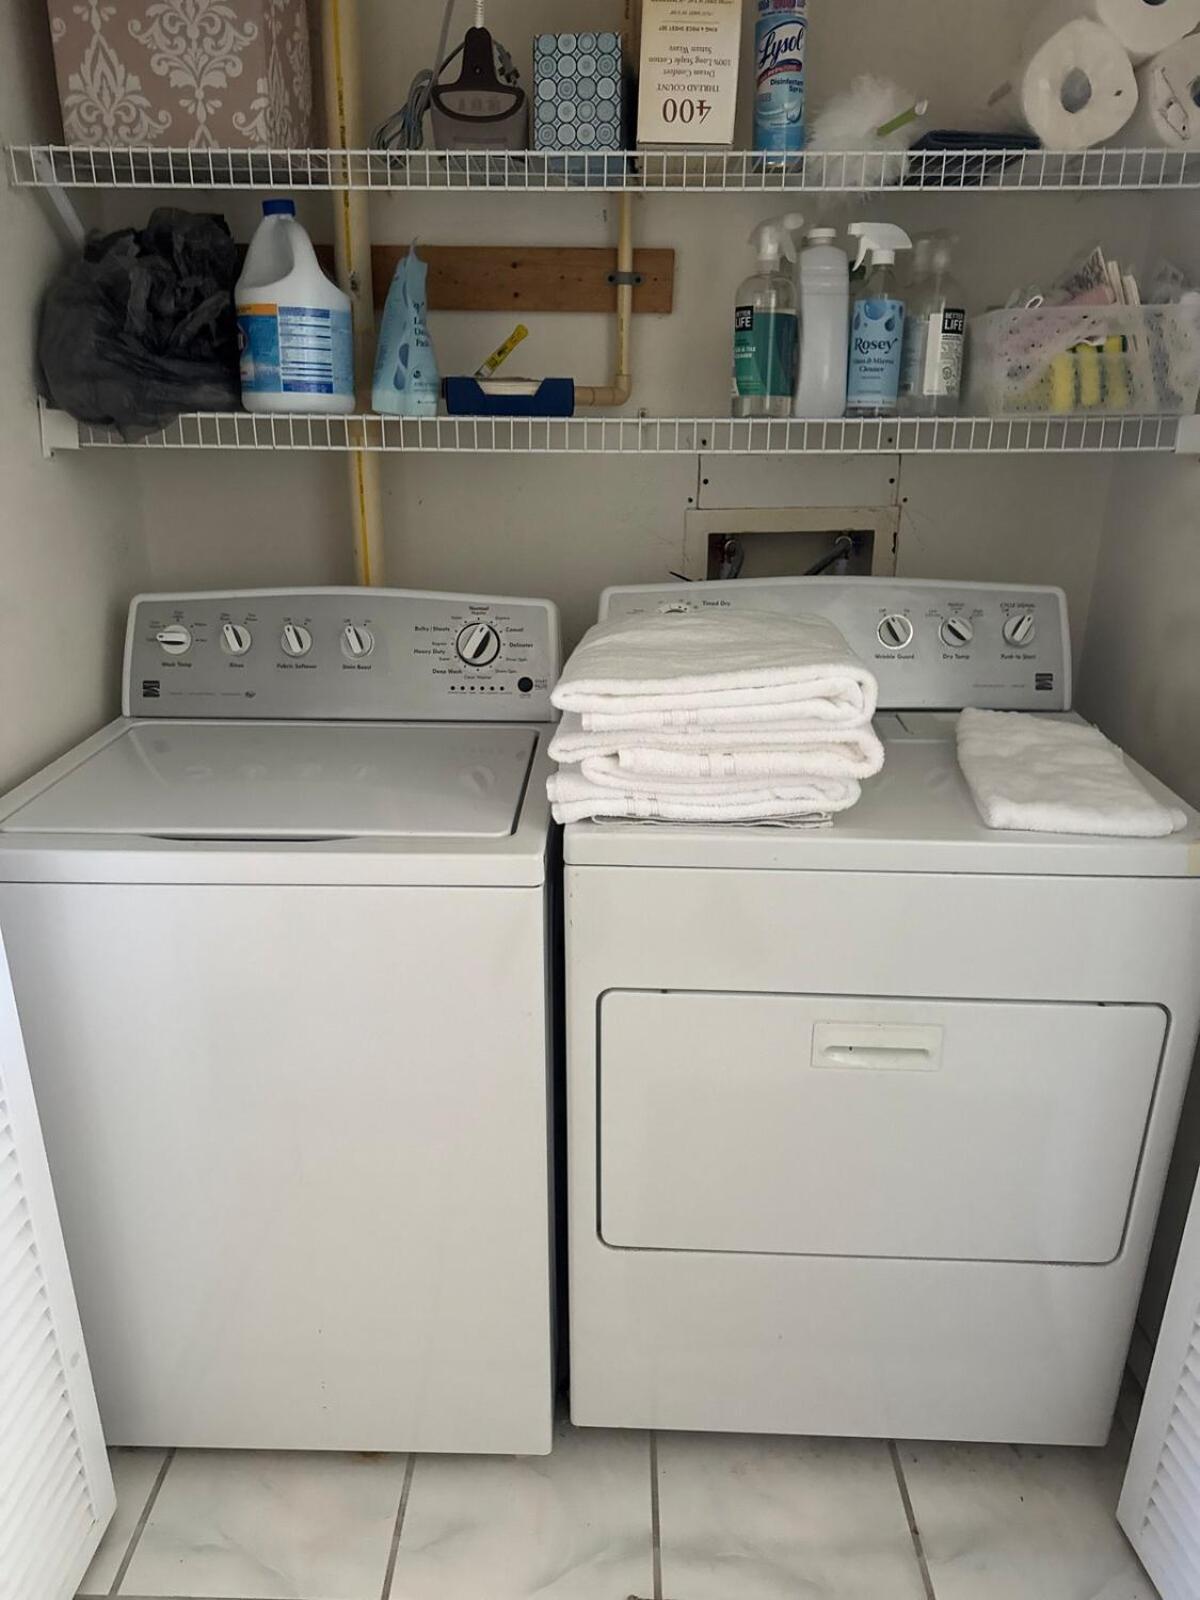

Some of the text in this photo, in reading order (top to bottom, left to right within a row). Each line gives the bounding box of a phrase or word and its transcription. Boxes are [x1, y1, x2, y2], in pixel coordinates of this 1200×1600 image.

[668, 45, 689, 54] Weave
[758, 27, 804, 69] Lysol
[648, 55, 732, 67] 100% Long Staple Cotton
[663, 67, 716, 78] Dream Comfort
[657, 83, 719, 92] THREAD COUNT
[663, 98, 712, 124] 400
[943, 319, 964, 332] LIFE
[854, 337, 899, 355] Rosey
[954, 653, 971, 661] Temp
